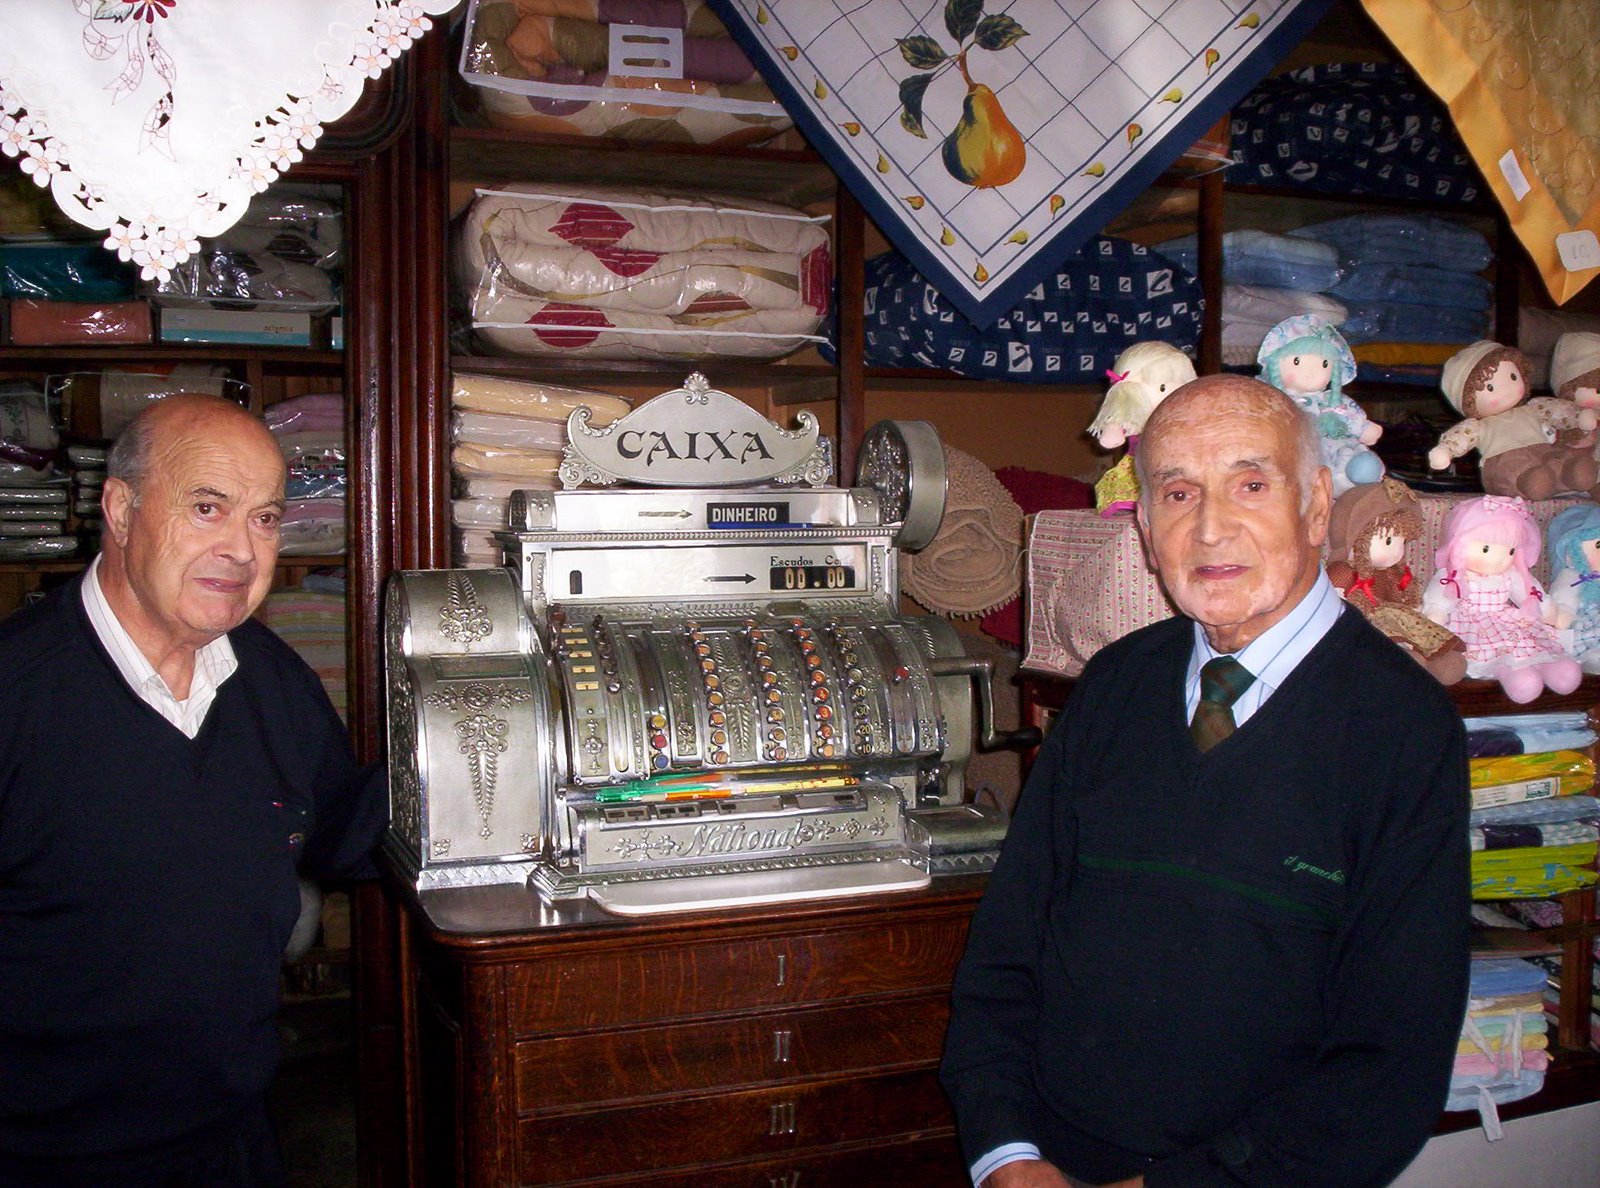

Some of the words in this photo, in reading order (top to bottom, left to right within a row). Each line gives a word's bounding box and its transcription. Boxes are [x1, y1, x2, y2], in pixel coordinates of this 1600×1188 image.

[616, 429, 775, 467] CAIXA
[712, 507, 778, 522] DINHEIRO
[770, 556, 814, 567] Escudos
[675, 818, 804, 856] National
